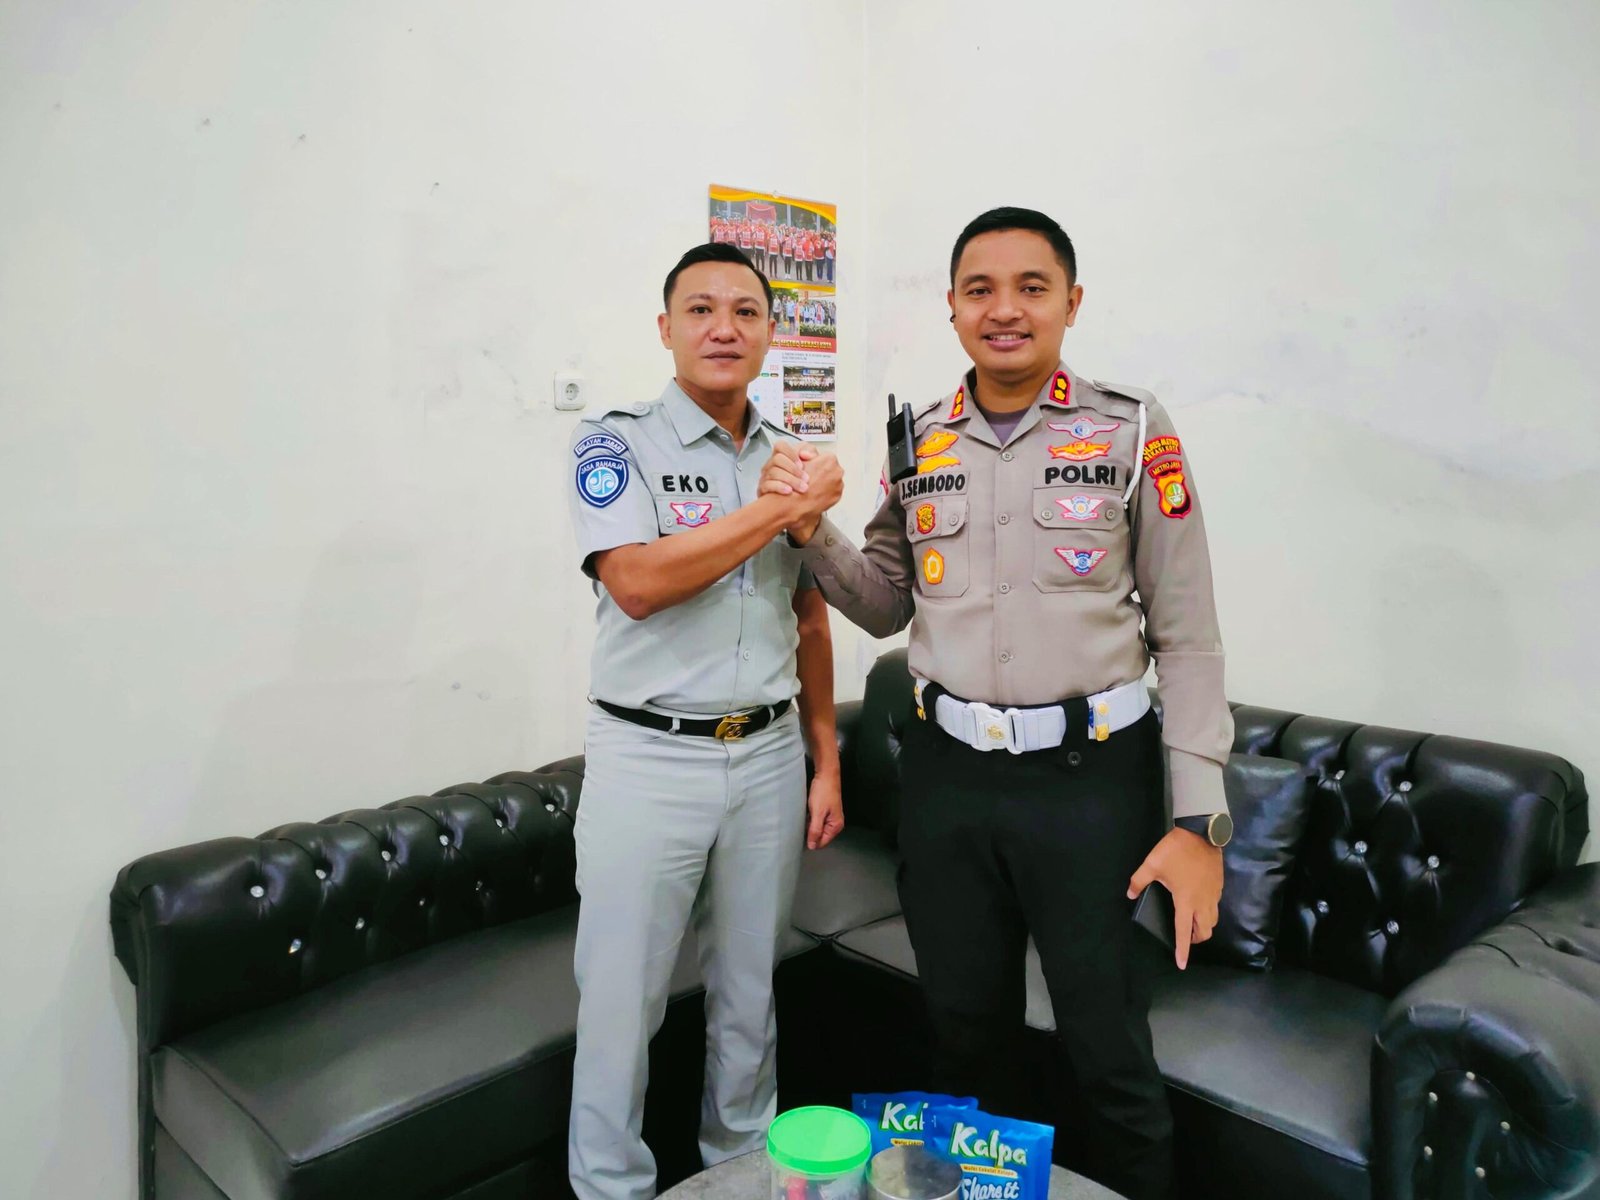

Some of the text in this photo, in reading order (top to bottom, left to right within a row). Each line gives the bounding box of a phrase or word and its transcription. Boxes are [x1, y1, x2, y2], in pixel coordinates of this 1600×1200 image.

[578, 438, 622, 453] WILAYAH JABAR
[581, 461, 623, 474] JASA RAHARJA
[1045, 465, 1116, 485] POLRI
[662, 475, 709, 493] EKO
[902, 474, 966, 500] J.SEMBODO
[951, 1122, 1027, 1168] Kalpa
[1004, 1181, 1020, 1200] it
